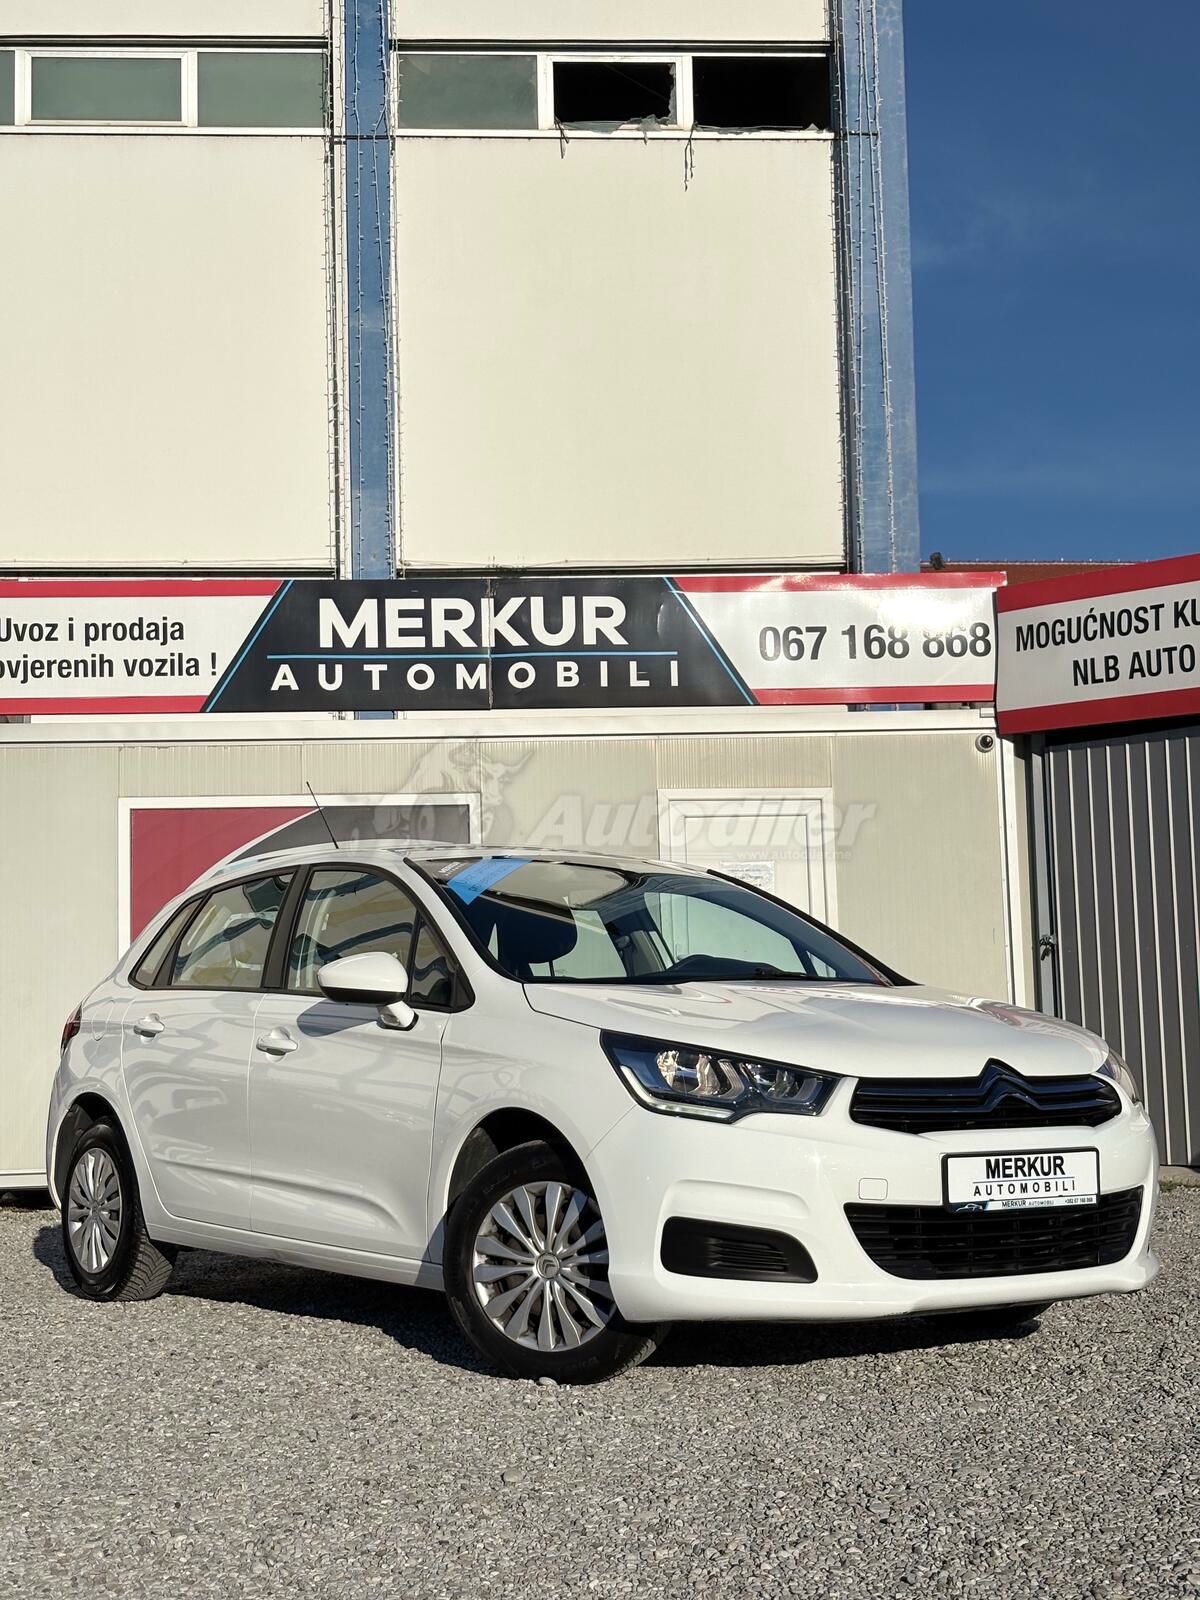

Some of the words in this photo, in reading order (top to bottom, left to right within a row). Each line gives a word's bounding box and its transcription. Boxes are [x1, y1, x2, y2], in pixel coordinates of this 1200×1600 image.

[0, 617, 59, 642] Uvoz
[68, 616, 75, 641] i
[85, 615, 184, 647] prodaja
[318, 596, 629, 648] MERKUR
[1015, 602, 1165, 652] MOGUĆNOST
[1173, 599, 1200, 629] KU
[758, 625, 828, 662] 067
[841, 623, 910, 661] 168
[922, 621, 992, 659] 868
[123, 652, 200, 677] vozila
[210, 652, 217, 676] !
[270, 660, 679, 692] AUTOMOBILI
[1072, 655, 1120, 687] NLB
[1128, 643, 1196, 681] AUTO
[985, 1155, 1066, 1179] MERKUR
[973, 1179, 1076, 1197] AUTOMOBILI
[1001, 1199, 1027, 1208] MERKUR
